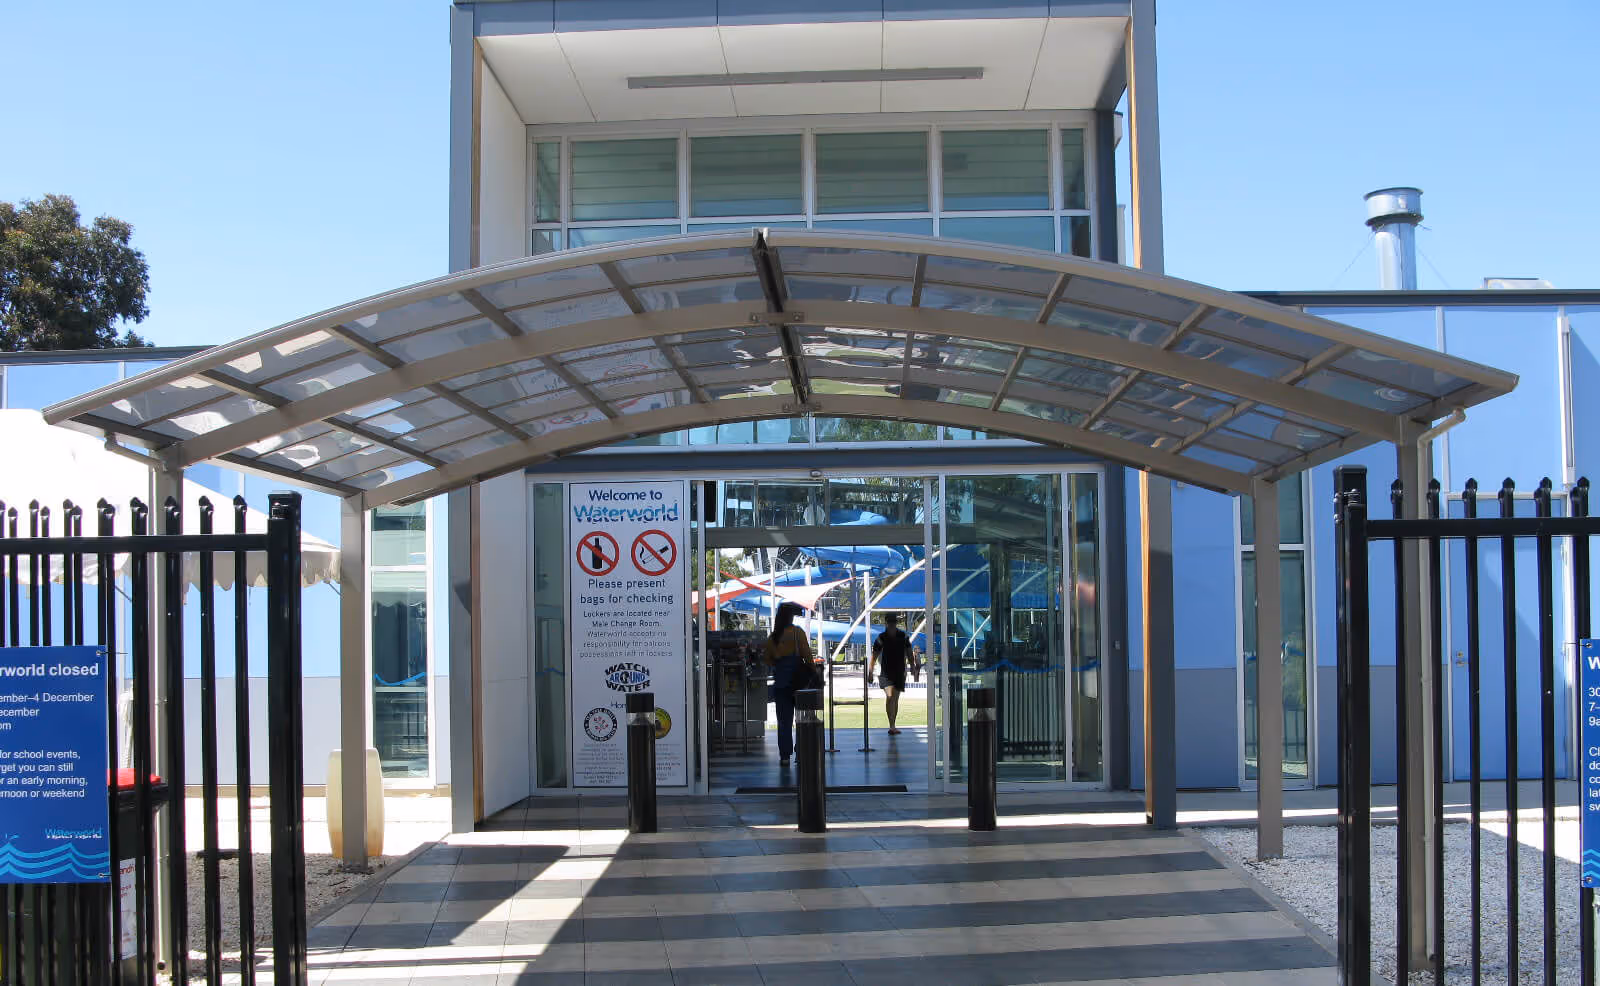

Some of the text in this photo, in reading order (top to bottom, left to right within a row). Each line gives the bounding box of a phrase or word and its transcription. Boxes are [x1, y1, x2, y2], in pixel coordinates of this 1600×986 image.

[588, 489, 663, 501] Welcome to
[573, 502, 679, 523] Waterworld
[588, 579, 666, 590] Please present
[580, 592, 674, 605] bags for checking
[583, 610, 611, 618] Lockers
[626, 609, 652, 617] located
[610, 619, 637, 629] Change
[587, 630, 627, 638] Waterworld
[49, 662, 99, 676] closed
[604, 662, 650, 676] WATCH
[605, 679, 651, 693] WATER
[42, 691, 94, 703] December
[13, 749, 44, 759] school
[46, 750, 81, 761] events,
[19, 765, 36, 774] you
[57, 762, 74, 772] still
[7, 777, 19, 785] an
[21, 776, 45, 787] early
[47, 776, 89, 787] morning,
[30, 790, 41, 798] or
[42, 788, 85, 798] weekend
